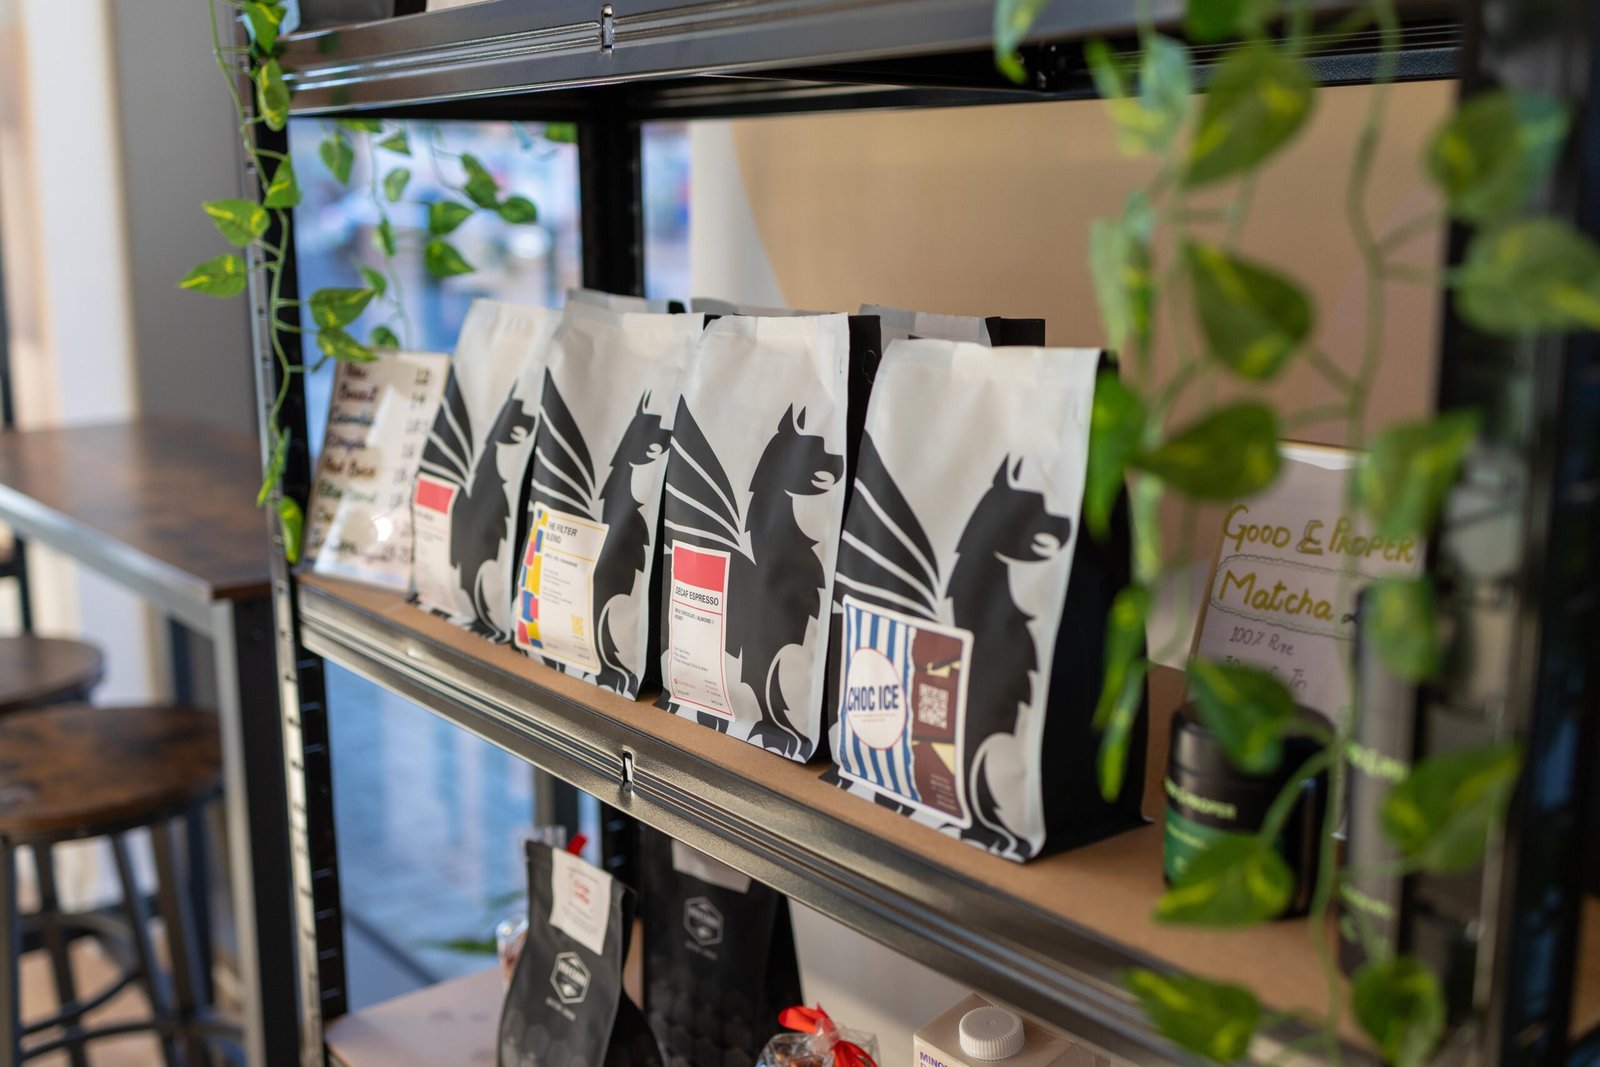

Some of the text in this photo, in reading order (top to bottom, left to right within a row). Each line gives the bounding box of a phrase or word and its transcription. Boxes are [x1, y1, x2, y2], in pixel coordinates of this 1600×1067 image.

[556, 524, 578, 537] FILTER
[675, 586, 719, 607] DECAF ESPRESSO
[1219, 570, 1334, 622] Matcha
[1229, 626, 1265, 646] 100%
[847, 685, 899, 712] CHOC ICE
